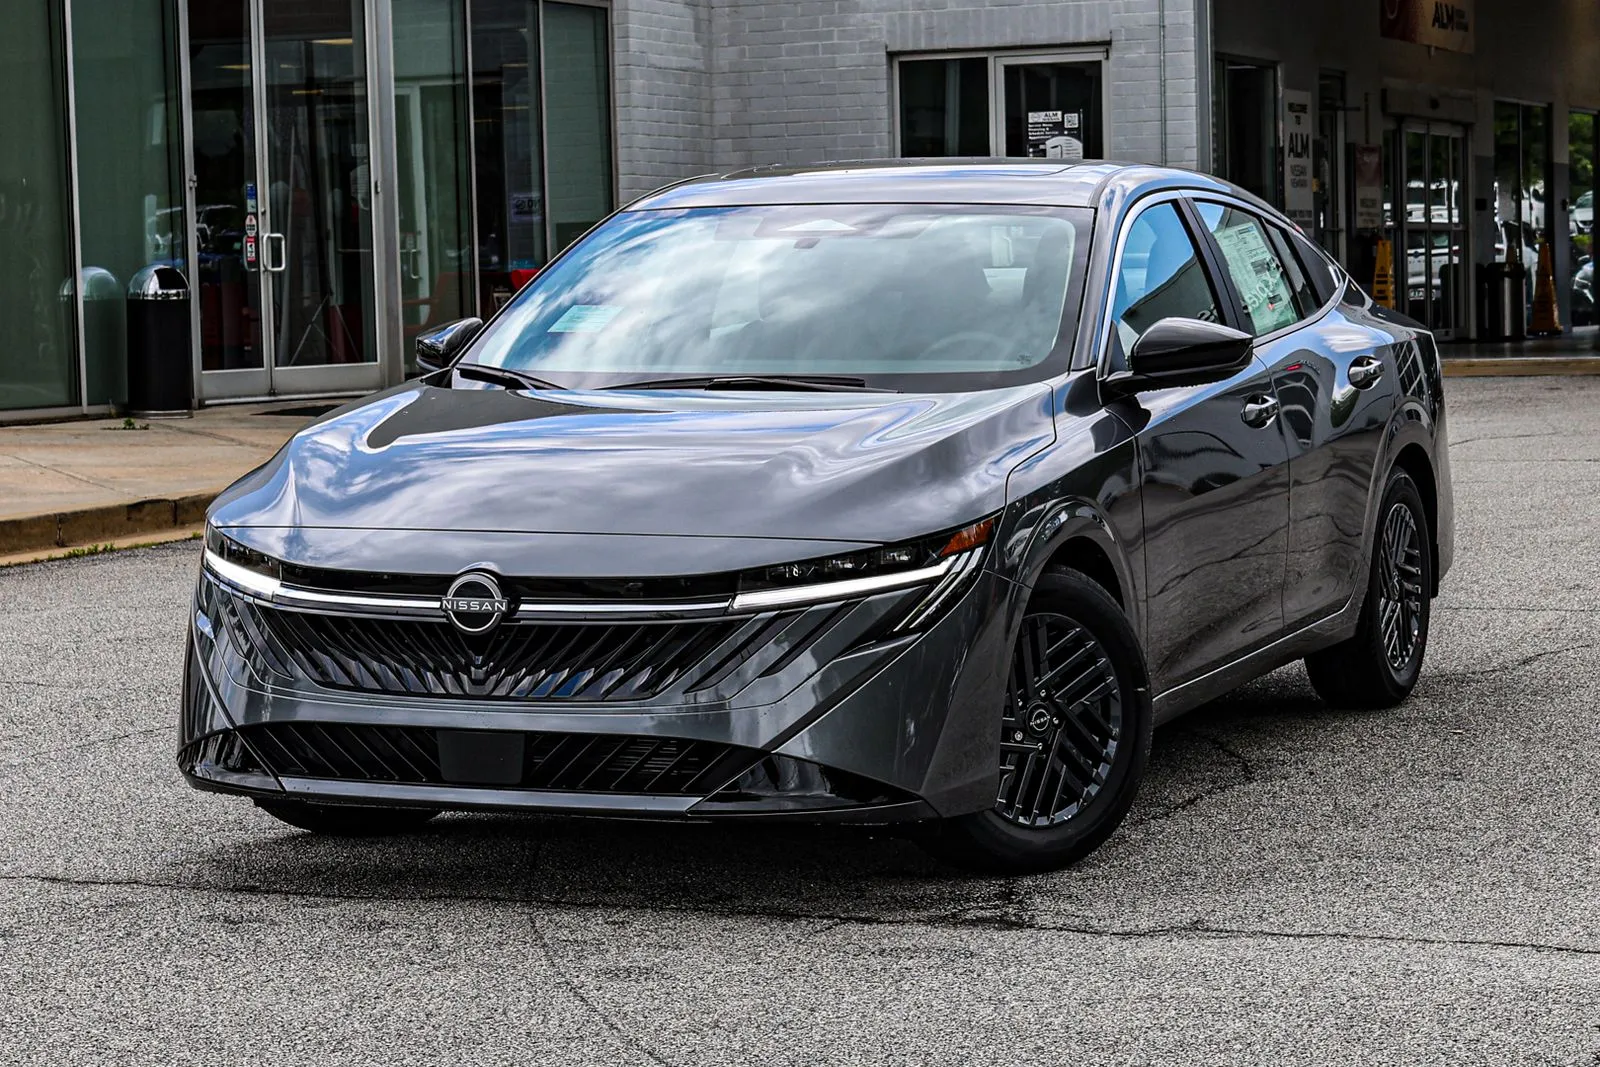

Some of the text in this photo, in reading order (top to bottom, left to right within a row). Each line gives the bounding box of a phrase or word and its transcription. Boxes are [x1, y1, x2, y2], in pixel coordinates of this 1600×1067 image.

[1431, 1, 1454, 32] ALM
[1288, 132, 1310, 159] ALM
[442, 600, 506, 611] NISSAN
